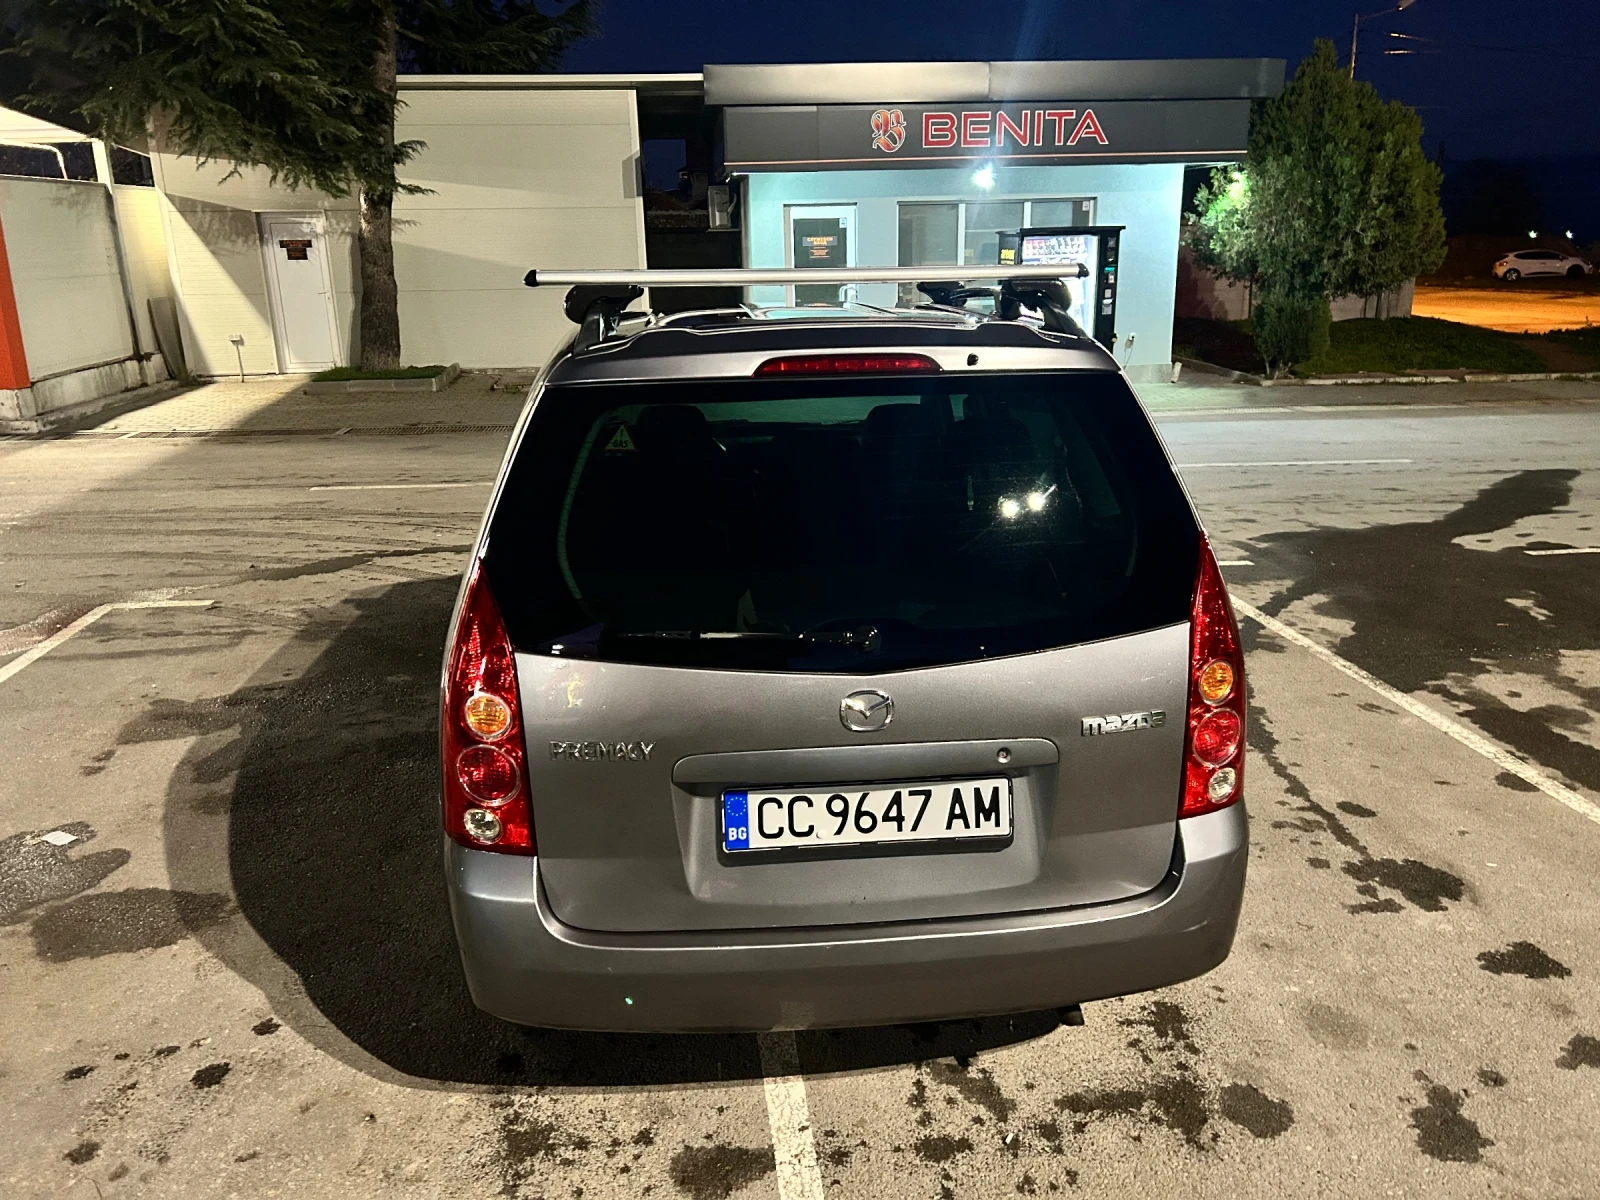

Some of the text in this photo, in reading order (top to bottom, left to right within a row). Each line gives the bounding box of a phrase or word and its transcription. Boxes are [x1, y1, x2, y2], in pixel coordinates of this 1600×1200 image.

[922, 109, 1109, 149] BENITA
[613, 439, 629, 448] GAS
[550, 741, 656, 761] PREMACY
[757, 786, 1001, 839] CC 9647 AM
[728, 827, 747, 841] BG
